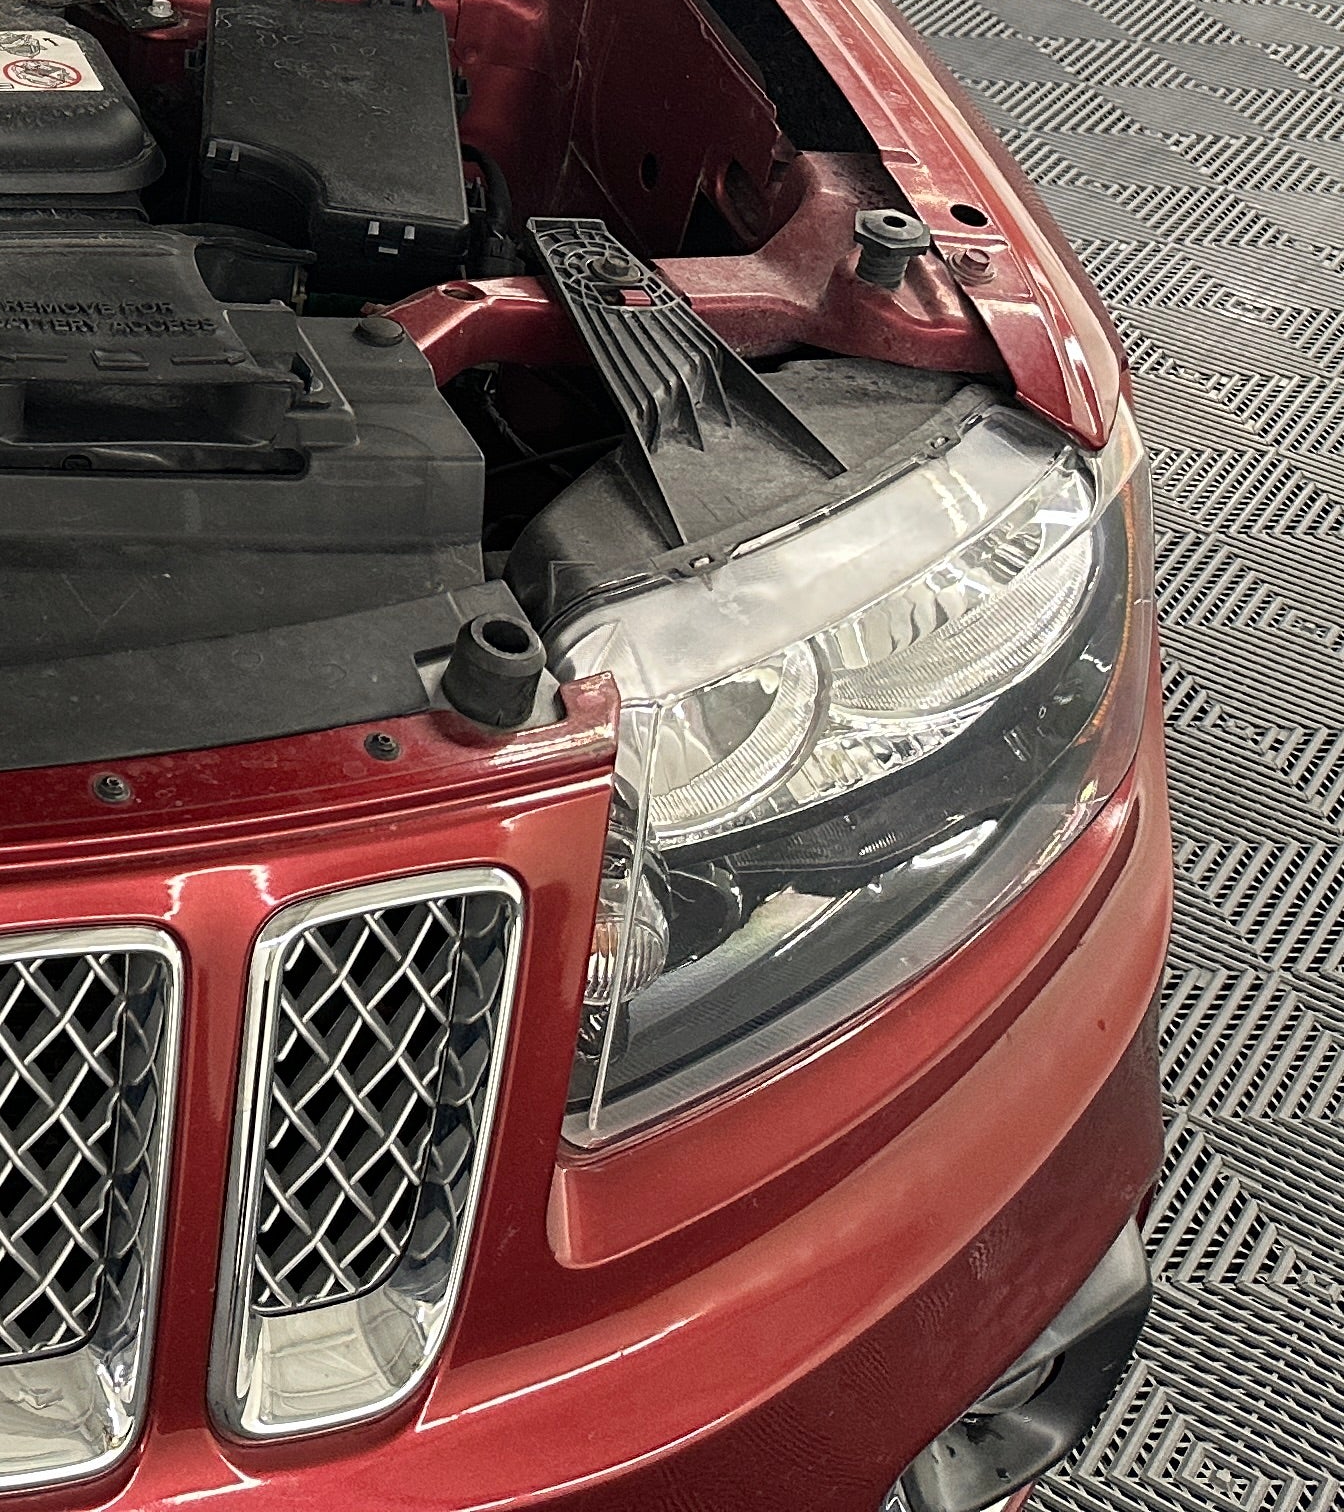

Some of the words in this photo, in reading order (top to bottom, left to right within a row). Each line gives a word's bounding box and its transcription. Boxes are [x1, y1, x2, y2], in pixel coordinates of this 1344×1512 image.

[0, 299, 114, 315] REMOVE
[119, 300, 174, 315] FOR
[113, 317, 218, 334] ACCESS
